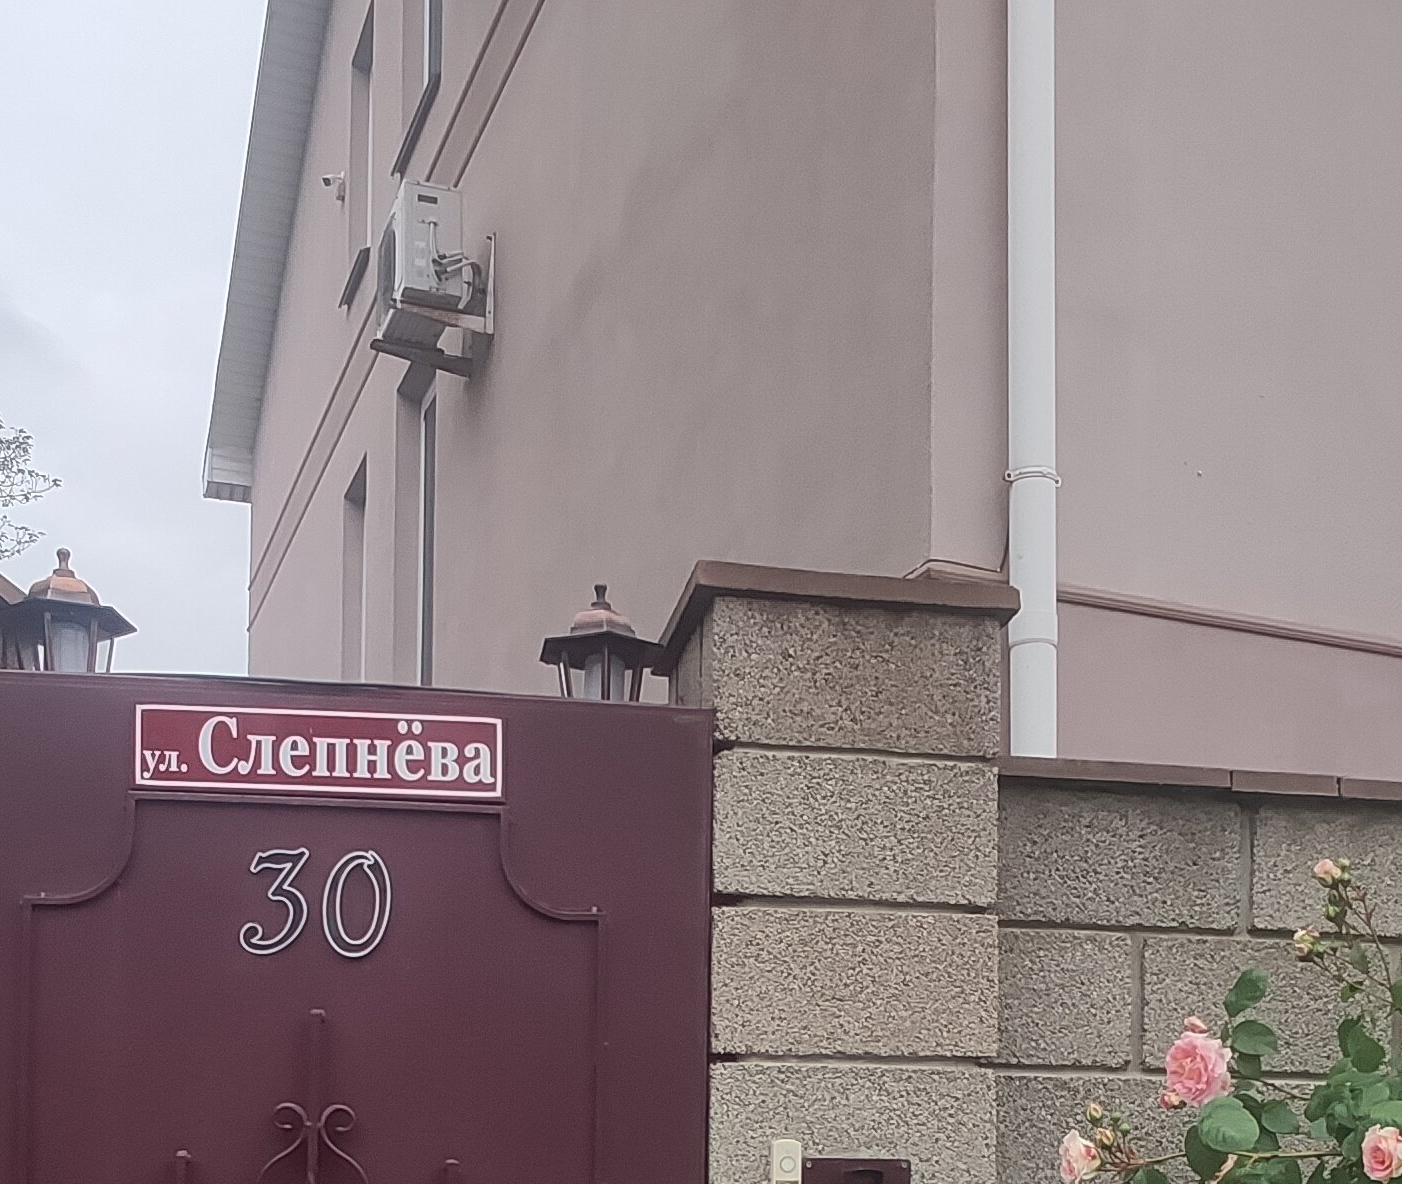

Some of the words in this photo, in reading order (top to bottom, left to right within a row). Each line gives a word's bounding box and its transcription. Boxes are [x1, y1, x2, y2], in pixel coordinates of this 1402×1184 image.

[142, 749, 189, 778] ул.
[198, 715, 495, 783] Слепнёва
[240, 848, 391, 957] 30
